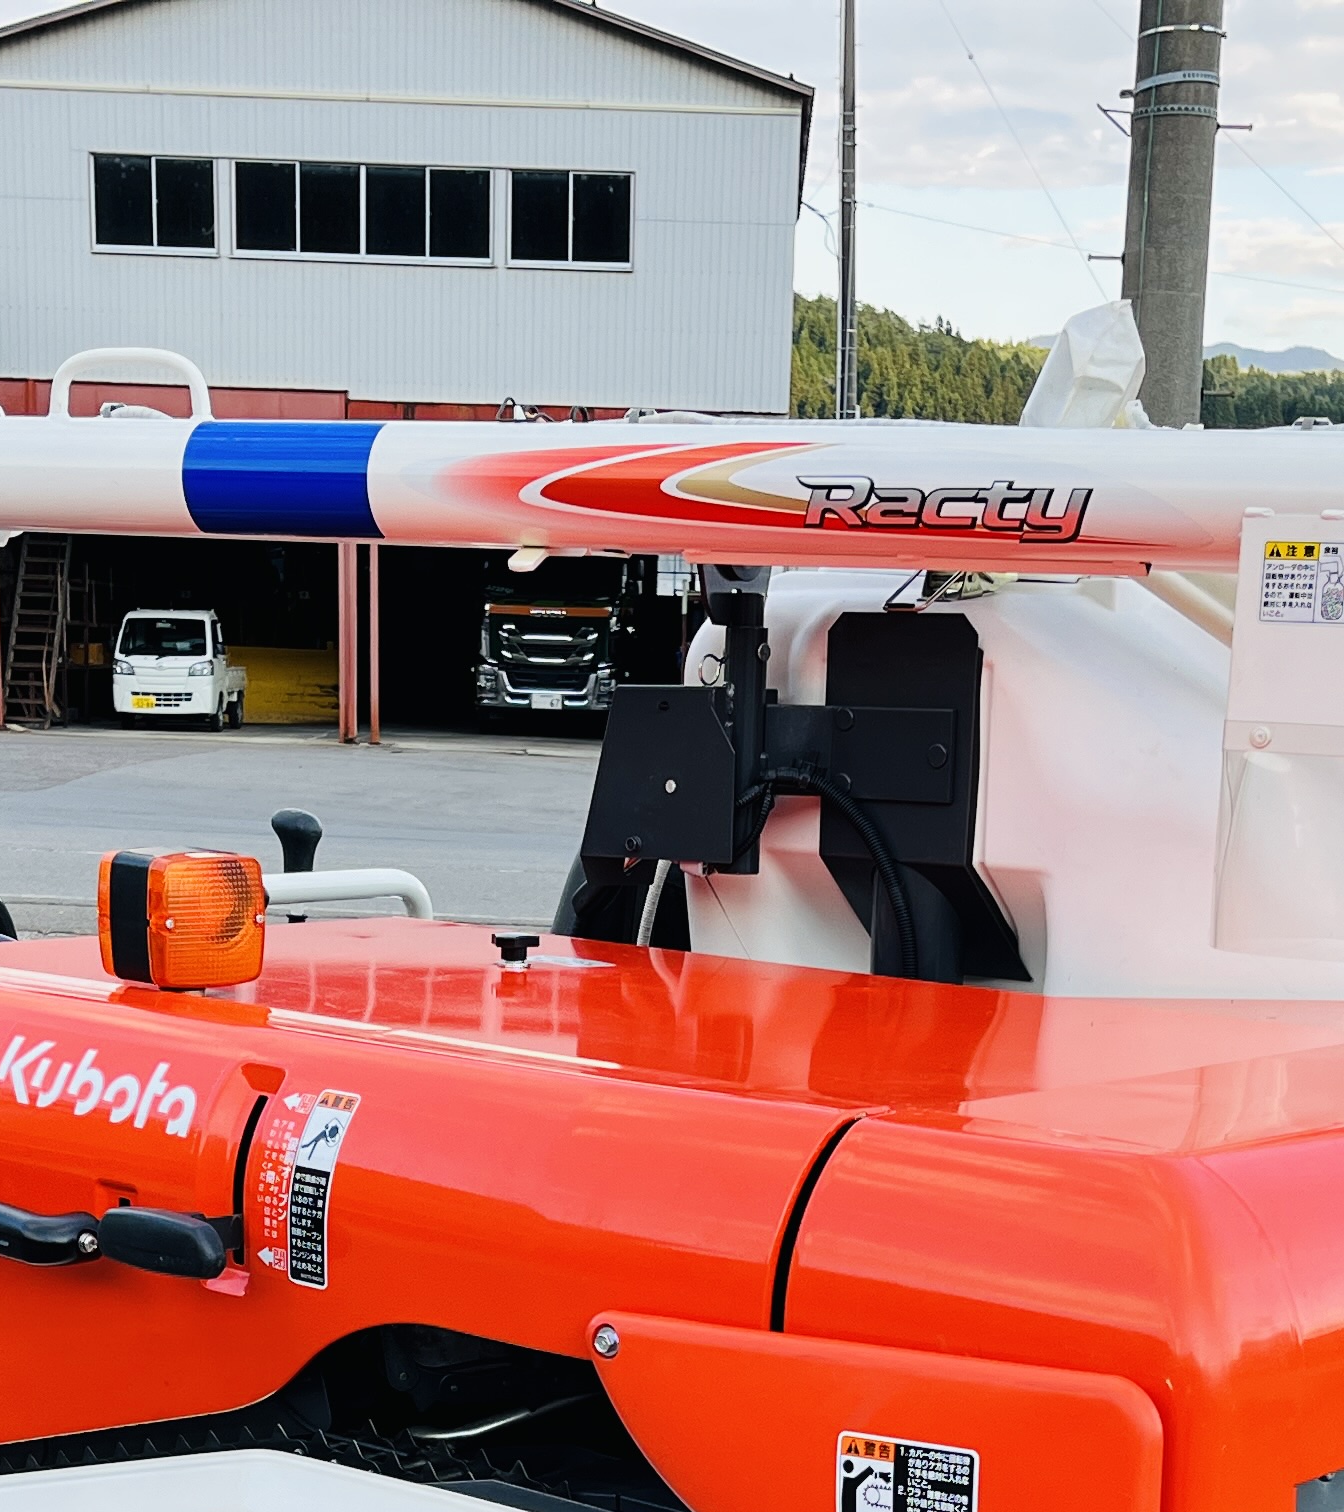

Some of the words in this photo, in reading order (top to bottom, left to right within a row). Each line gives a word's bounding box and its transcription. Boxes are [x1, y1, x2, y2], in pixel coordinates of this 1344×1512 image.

[796, 474, 1094, 544] Racty
[1286, 545, 1315, 557] 注意
[1266, 563, 1315, 571] アンローダの中に
[864, 1440, 891, 1460] 警告
